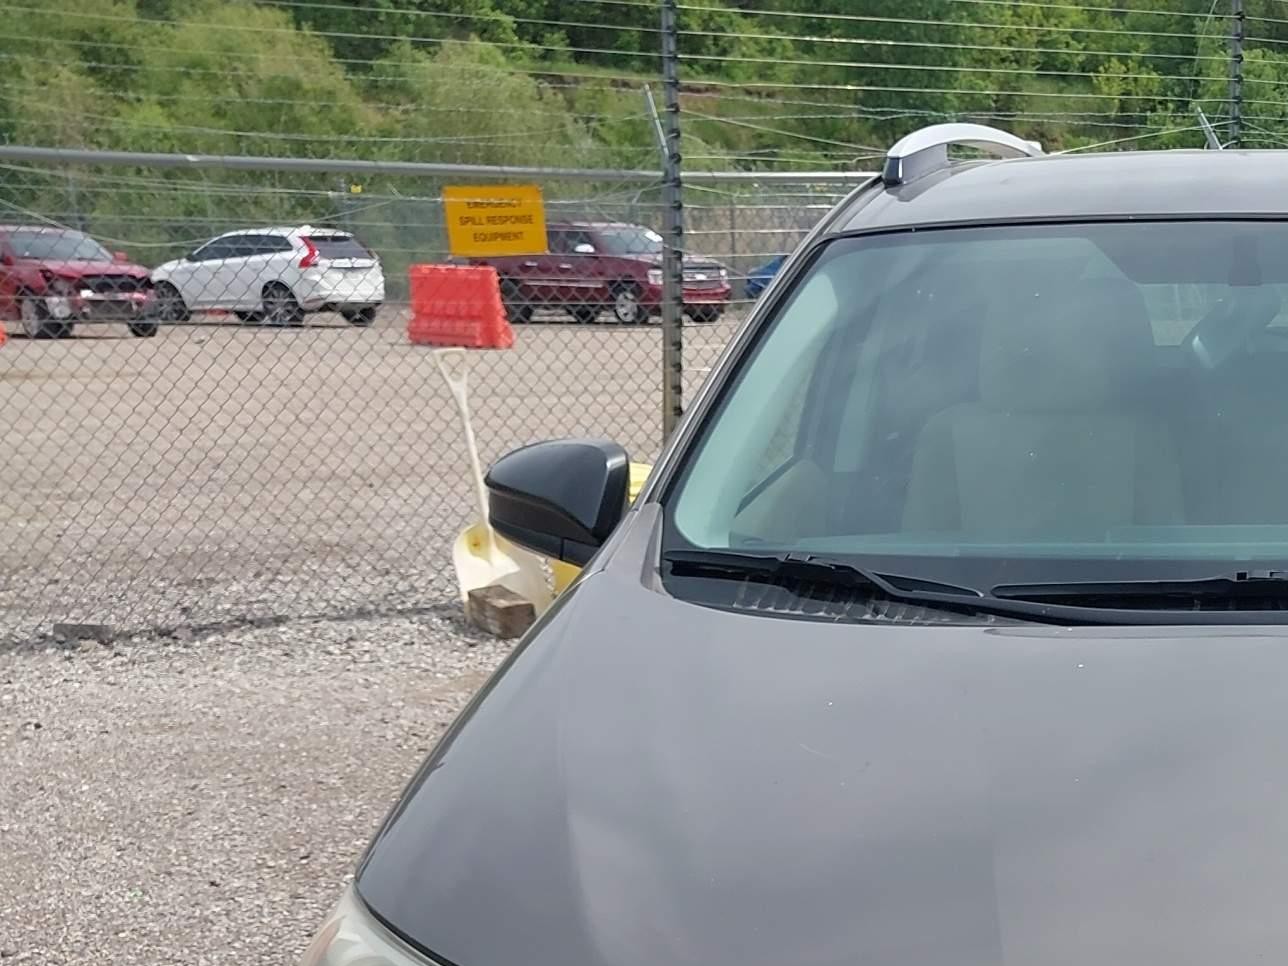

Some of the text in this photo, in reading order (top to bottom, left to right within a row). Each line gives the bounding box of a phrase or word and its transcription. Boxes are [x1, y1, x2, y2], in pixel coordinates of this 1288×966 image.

[459, 214, 534, 226] SPILL RESPONSE
[473, 231, 524, 242] EQUIPMENT
